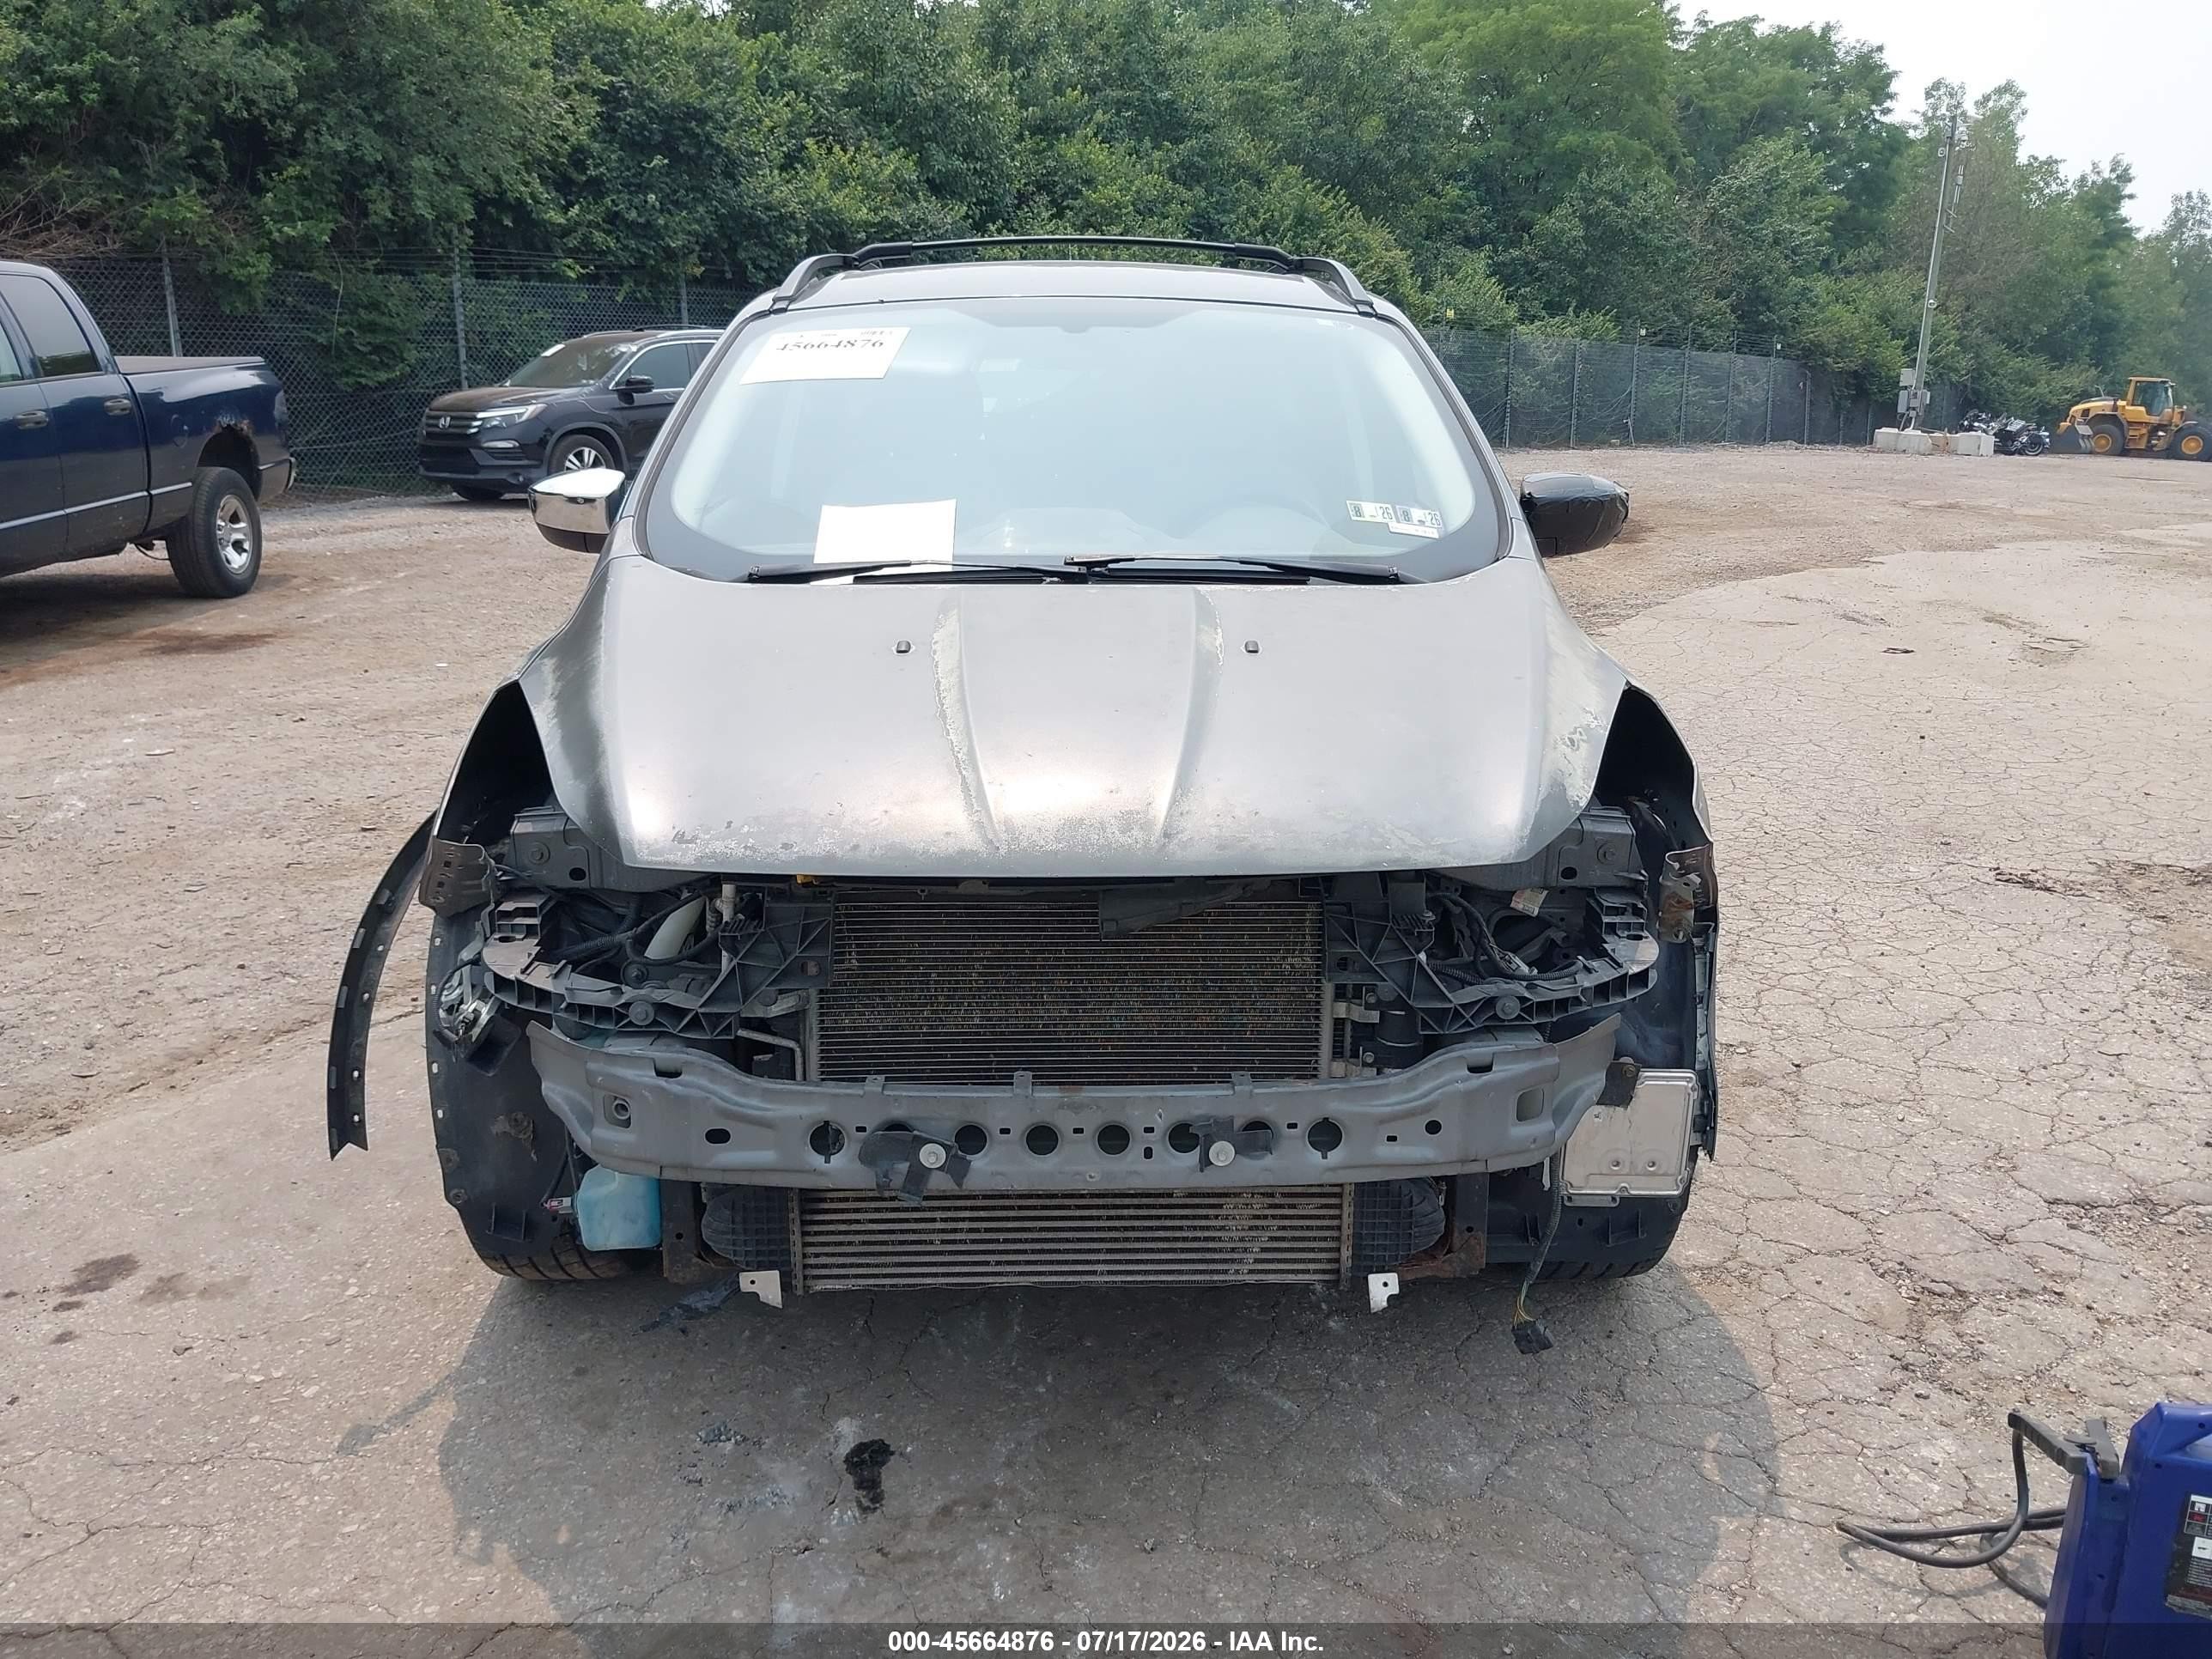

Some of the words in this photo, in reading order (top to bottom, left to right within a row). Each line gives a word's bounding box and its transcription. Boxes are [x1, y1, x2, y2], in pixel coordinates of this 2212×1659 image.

[775, 338, 884, 351] 45664876
[1379, 506, 1394, 520] 26
[1428, 512, 1442, 526] 26
